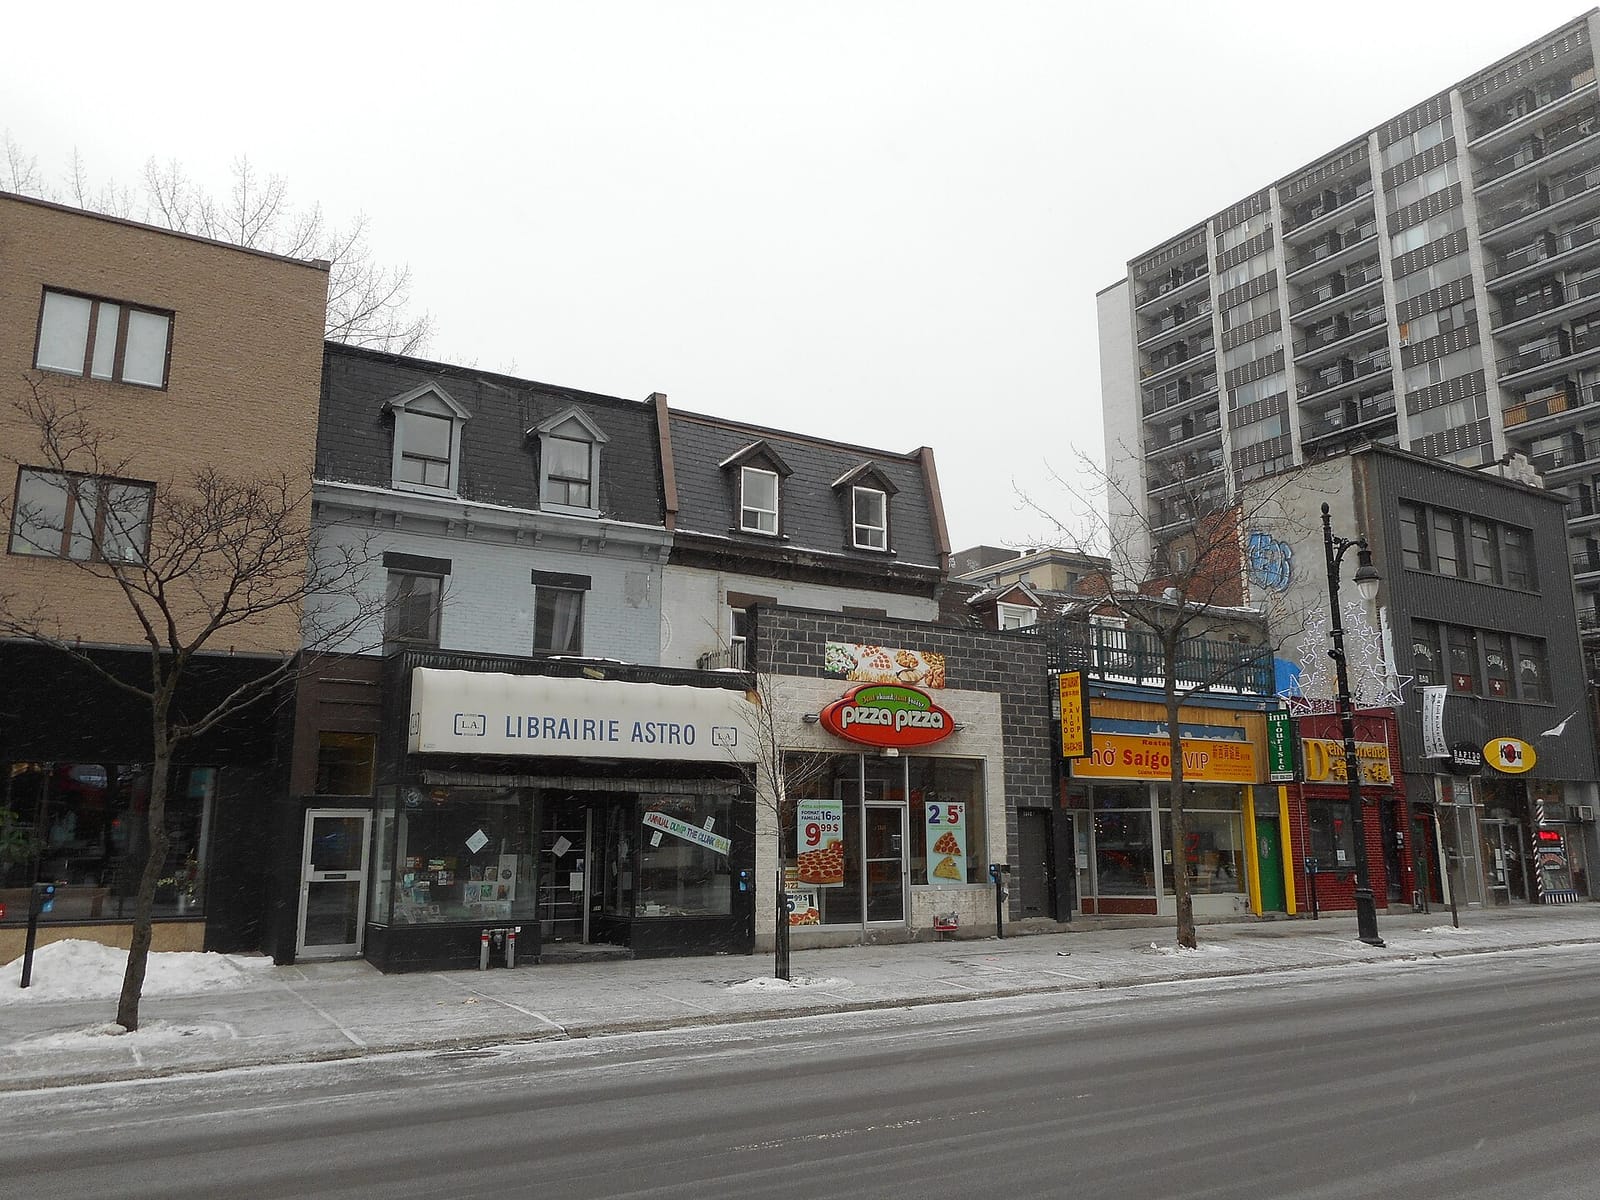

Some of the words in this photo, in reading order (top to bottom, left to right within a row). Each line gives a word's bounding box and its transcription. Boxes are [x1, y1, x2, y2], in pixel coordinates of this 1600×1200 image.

[841, 706, 893, 729] pizza
[895, 709, 943, 732] pizza
[1269, 713, 1288, 721] inn
[505, 715, 620, 742] LIBRAIRIE
[631, 721, 696, 746] ASTRO
[1122, 748, 1170, 770] Saigo
[1183, 751, 1209, 770] VIP
[928, 804, 941, 824] 2
[687, 827, 698, 839] THE
